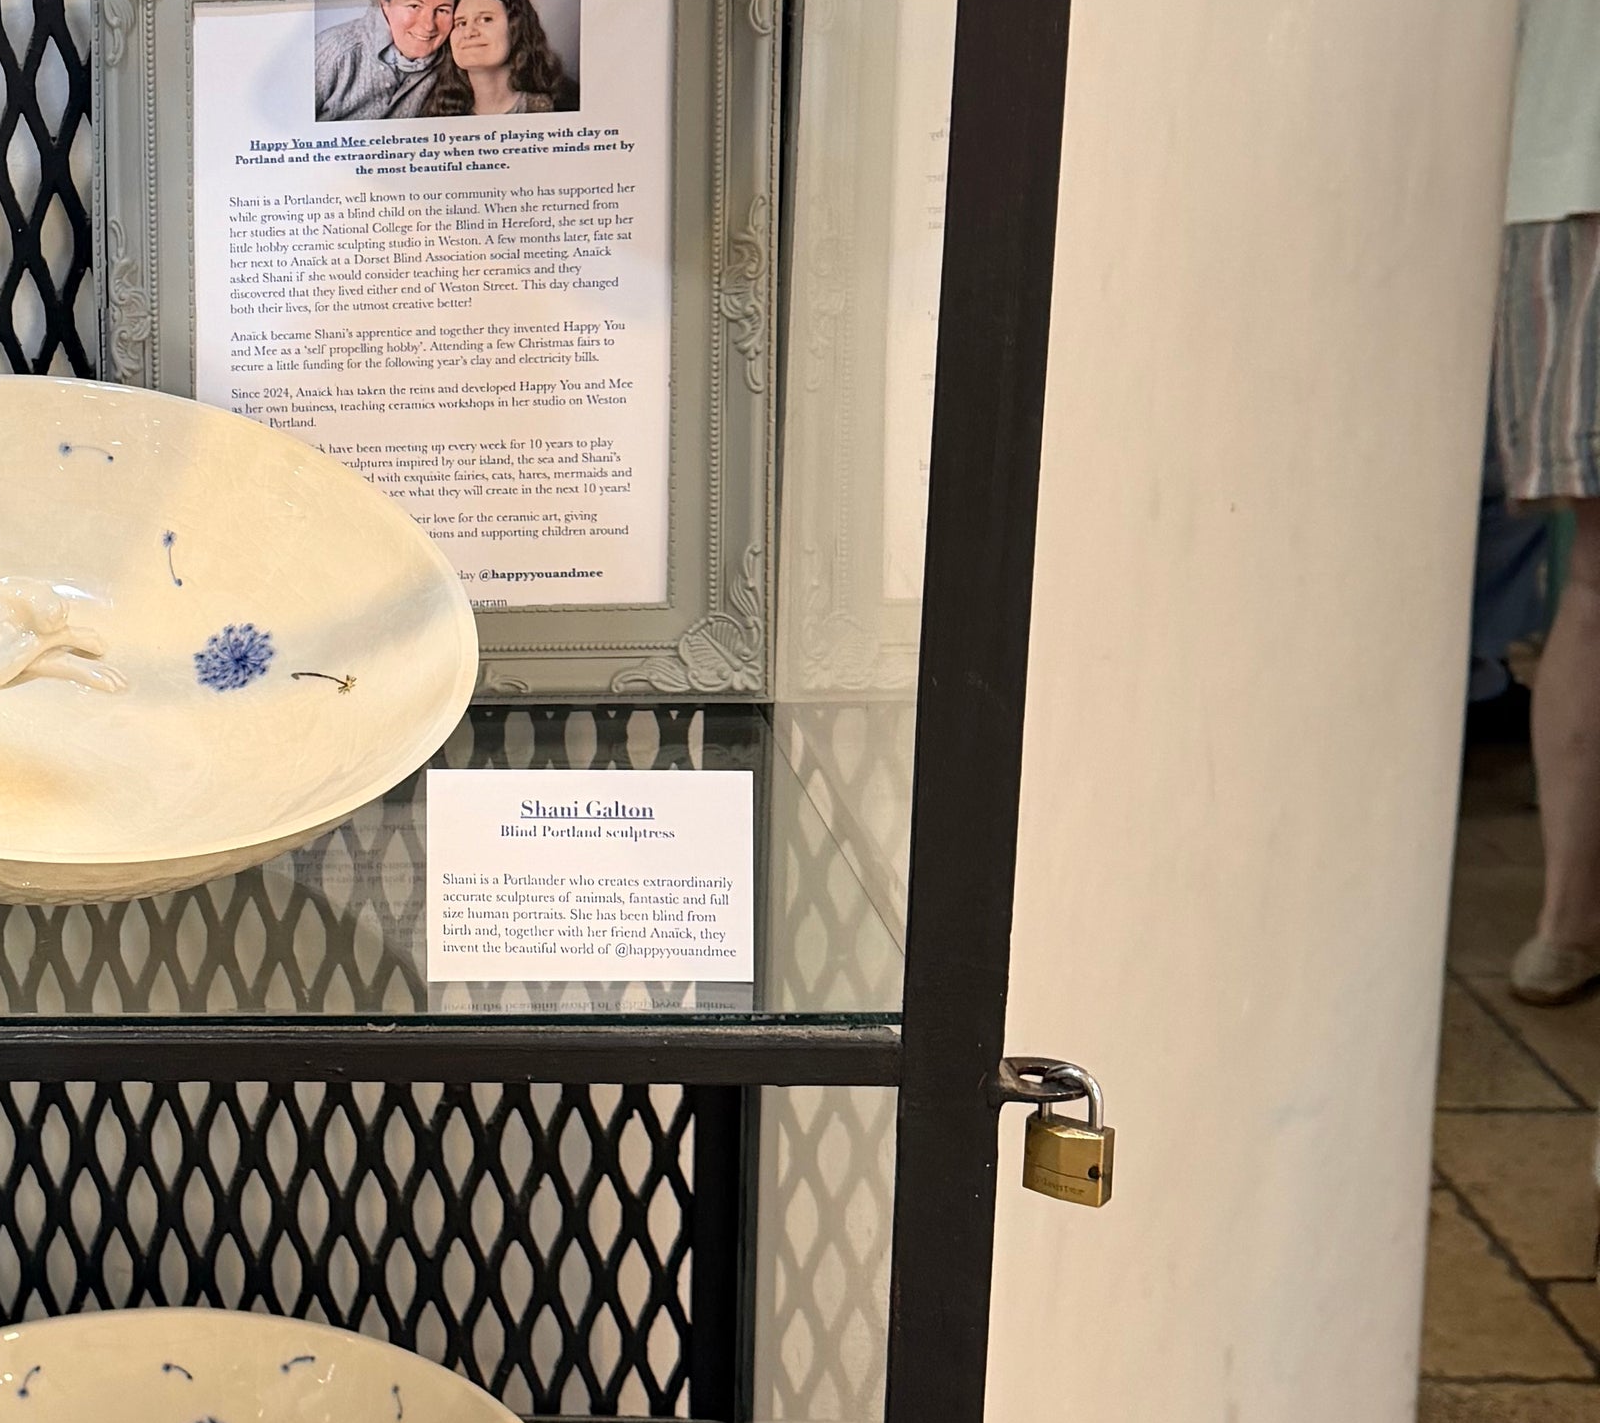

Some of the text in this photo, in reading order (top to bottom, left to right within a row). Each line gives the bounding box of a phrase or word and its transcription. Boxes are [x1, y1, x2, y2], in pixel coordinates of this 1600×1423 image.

[250, 126, 619, 153] Happy You and Mee celebrates 10 years of playing with clay on
[235, 153, 285, 165] Portland
[287, 152, 310, 163] and
[312, 152, 331, 162] the
[334, 149, 416, 161] extraordinary
[418, 148, 440, 160] day
[443, 146, 475, 156] when
[502, 143, 549, 154] creative
[552, 141, 590, 153] minds
[593, 142, 616, 151] met
[619, 140, 635, 153] by
[355, 160, 510, 175] the most beautiful chance.
[231, 387, 260, 399] Since
[263, 387, 293, 400] 2024,
[336, 385, 354, 396] has
[356, 385, 386, 396] taken
[389, 384, 406, 395] the
[409, 384, 435, 395] reins
[437, 382, 459, 393] and
[461, 380, 516, 395] developed
[519, 380, 557, 394] Happy
[559, 379, 581, 390] You
[584, 378, 605, 389] and
[608, 377, 633, 389] Mee
[479, 568, 604, 582] @happyyouandmee
[520, 800, 653, 818] Shani Galton
[500, 824, 675, 842] Blind Portland sculptress
[442, 872, 476, 885] Shani
[480, 873, 489, 884] is
[503, 873, 566, 886] Portlander
[569, 874, 594, 886] who
[597, 877, 639, 887] creates
[642, 875, 733, 891] extraordinarily
